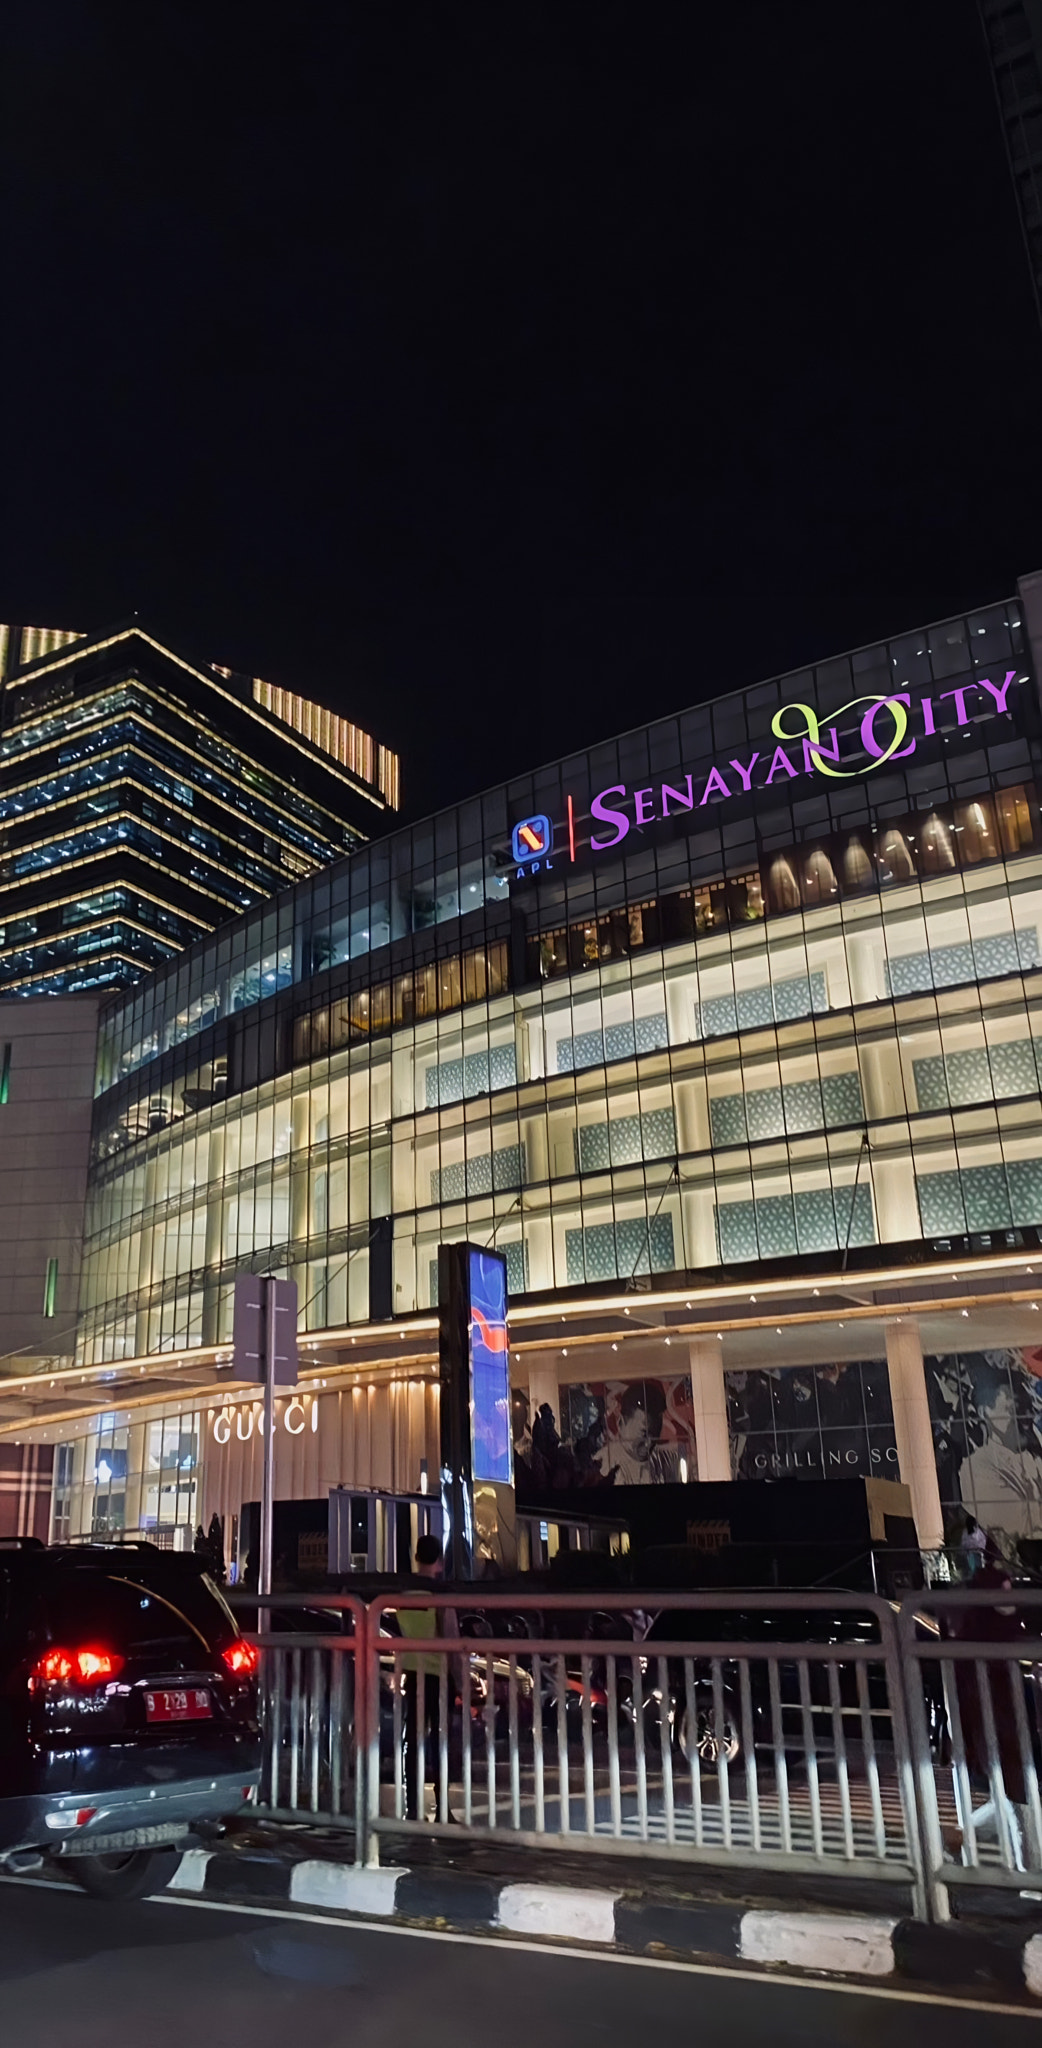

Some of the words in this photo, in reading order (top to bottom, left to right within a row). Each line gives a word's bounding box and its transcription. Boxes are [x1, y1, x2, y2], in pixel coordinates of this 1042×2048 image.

[590, 727, 841, 850] SENAYAN
[861, 670, 1017, 760] CITY
[516, 859, 554, 879] APL
